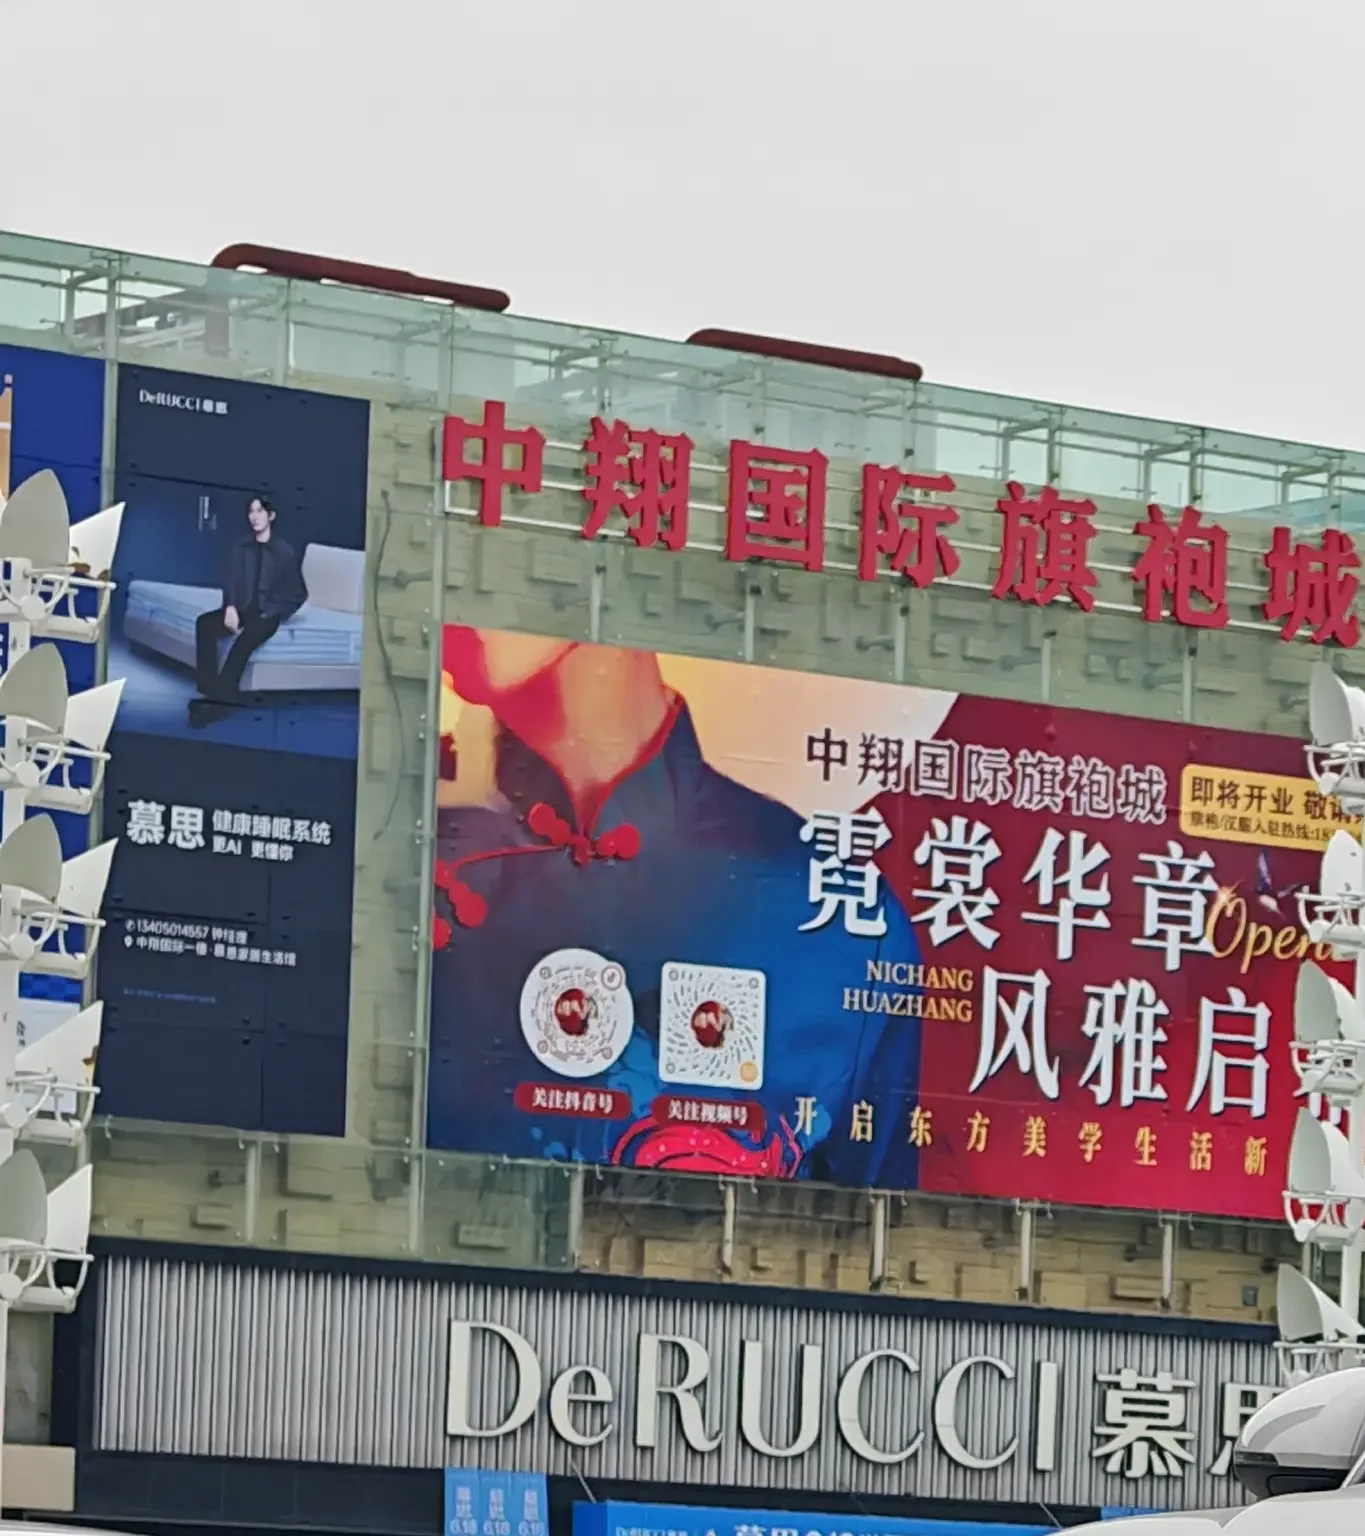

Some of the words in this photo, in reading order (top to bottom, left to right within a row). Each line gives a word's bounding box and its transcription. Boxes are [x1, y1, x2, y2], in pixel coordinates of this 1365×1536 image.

[442, 400, 1363, 650] 中翔国际旗袍城
[804, 727, 1168, 826] 中翔国际旗袍城
[1191, 774, 1296, 817] 即将开业
[126, 798, 206, 851] 慕思
[212, 808, 333, 846] 健康睡眠系统
[212, 834, 243, 856] 更AI
[796, 808, 1220, 974] 霓裳华章
[865, 959, 974, 994] NICHANG
[842, 987, 974, 1025] HUAZHANG
[443, 1318, 1058, 1474] DeRUCCI
